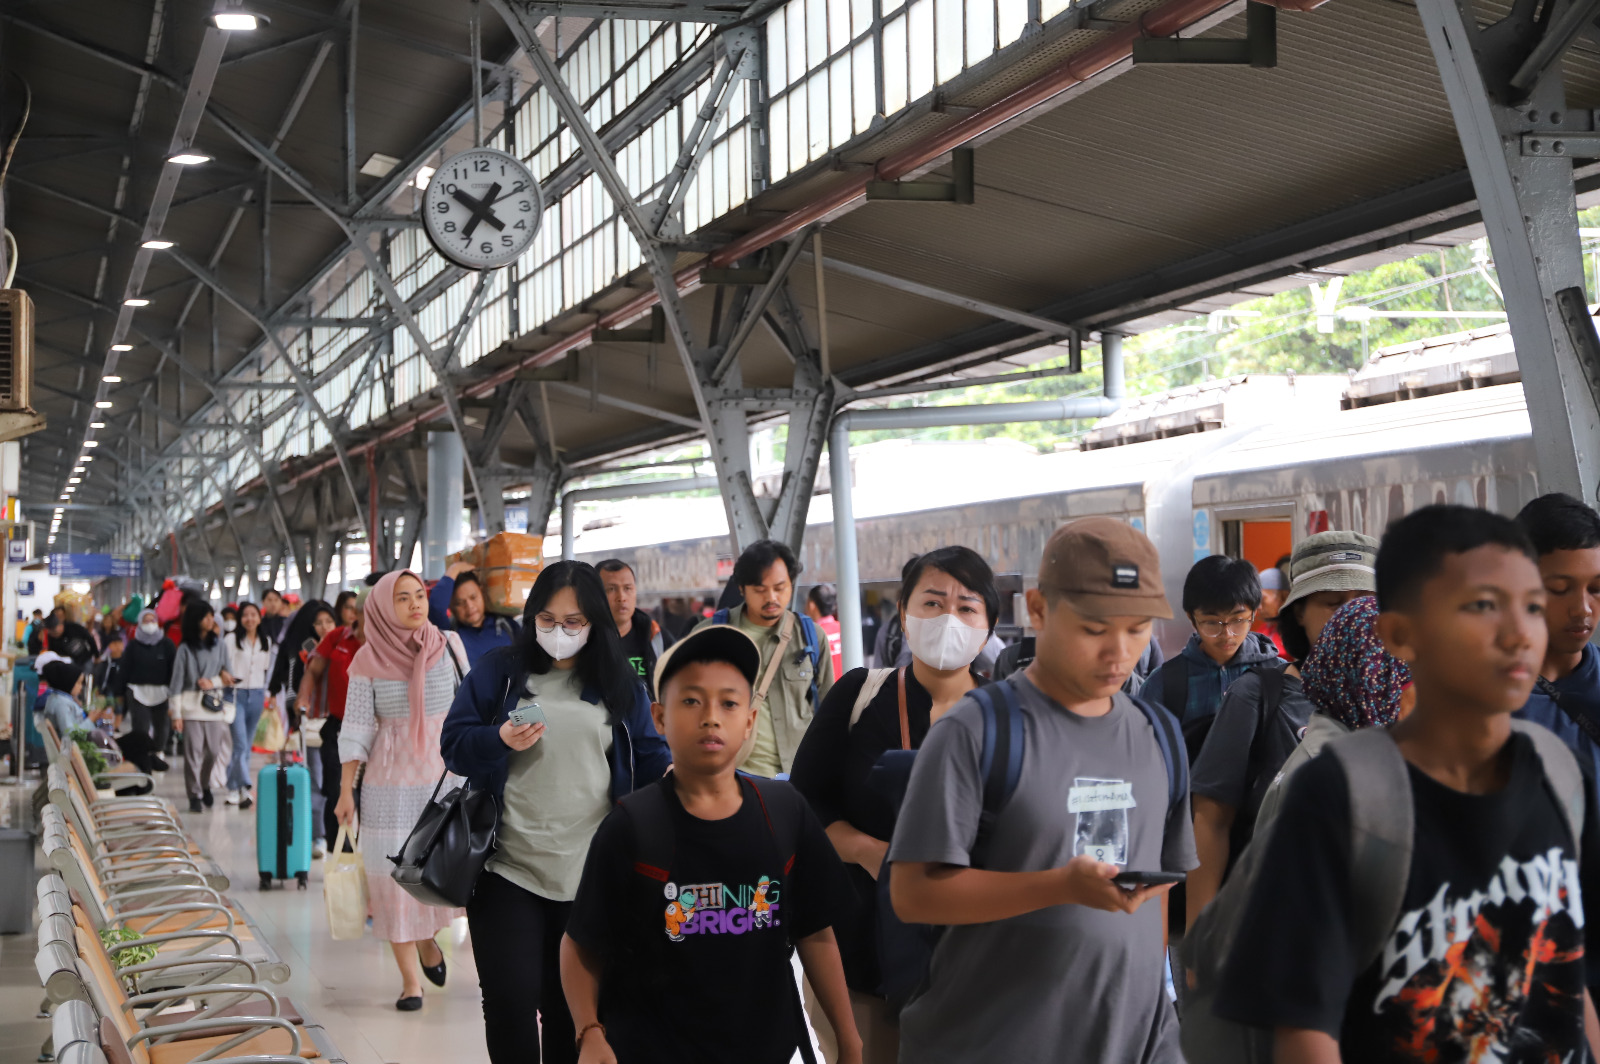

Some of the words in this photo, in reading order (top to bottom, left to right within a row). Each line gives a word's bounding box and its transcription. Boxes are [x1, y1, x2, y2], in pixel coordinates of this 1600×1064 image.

[474, 160, 490, 172] 12
[500, 165, 505, 176] 1
[453, 168, 468, 180] 11
[441, 183, 458, 195] 10
[512, 181, 525, 193] 2
[437, 202, 450, 214] 9
[519, 200, 531, 212] 3
[444, 221, 456, 233] 8
[513, 219, 526, 231] 4
[460, 236, 473, 249] 7
[501, 235, 514, 247] 5
[480, 242, 493, 254] 6
